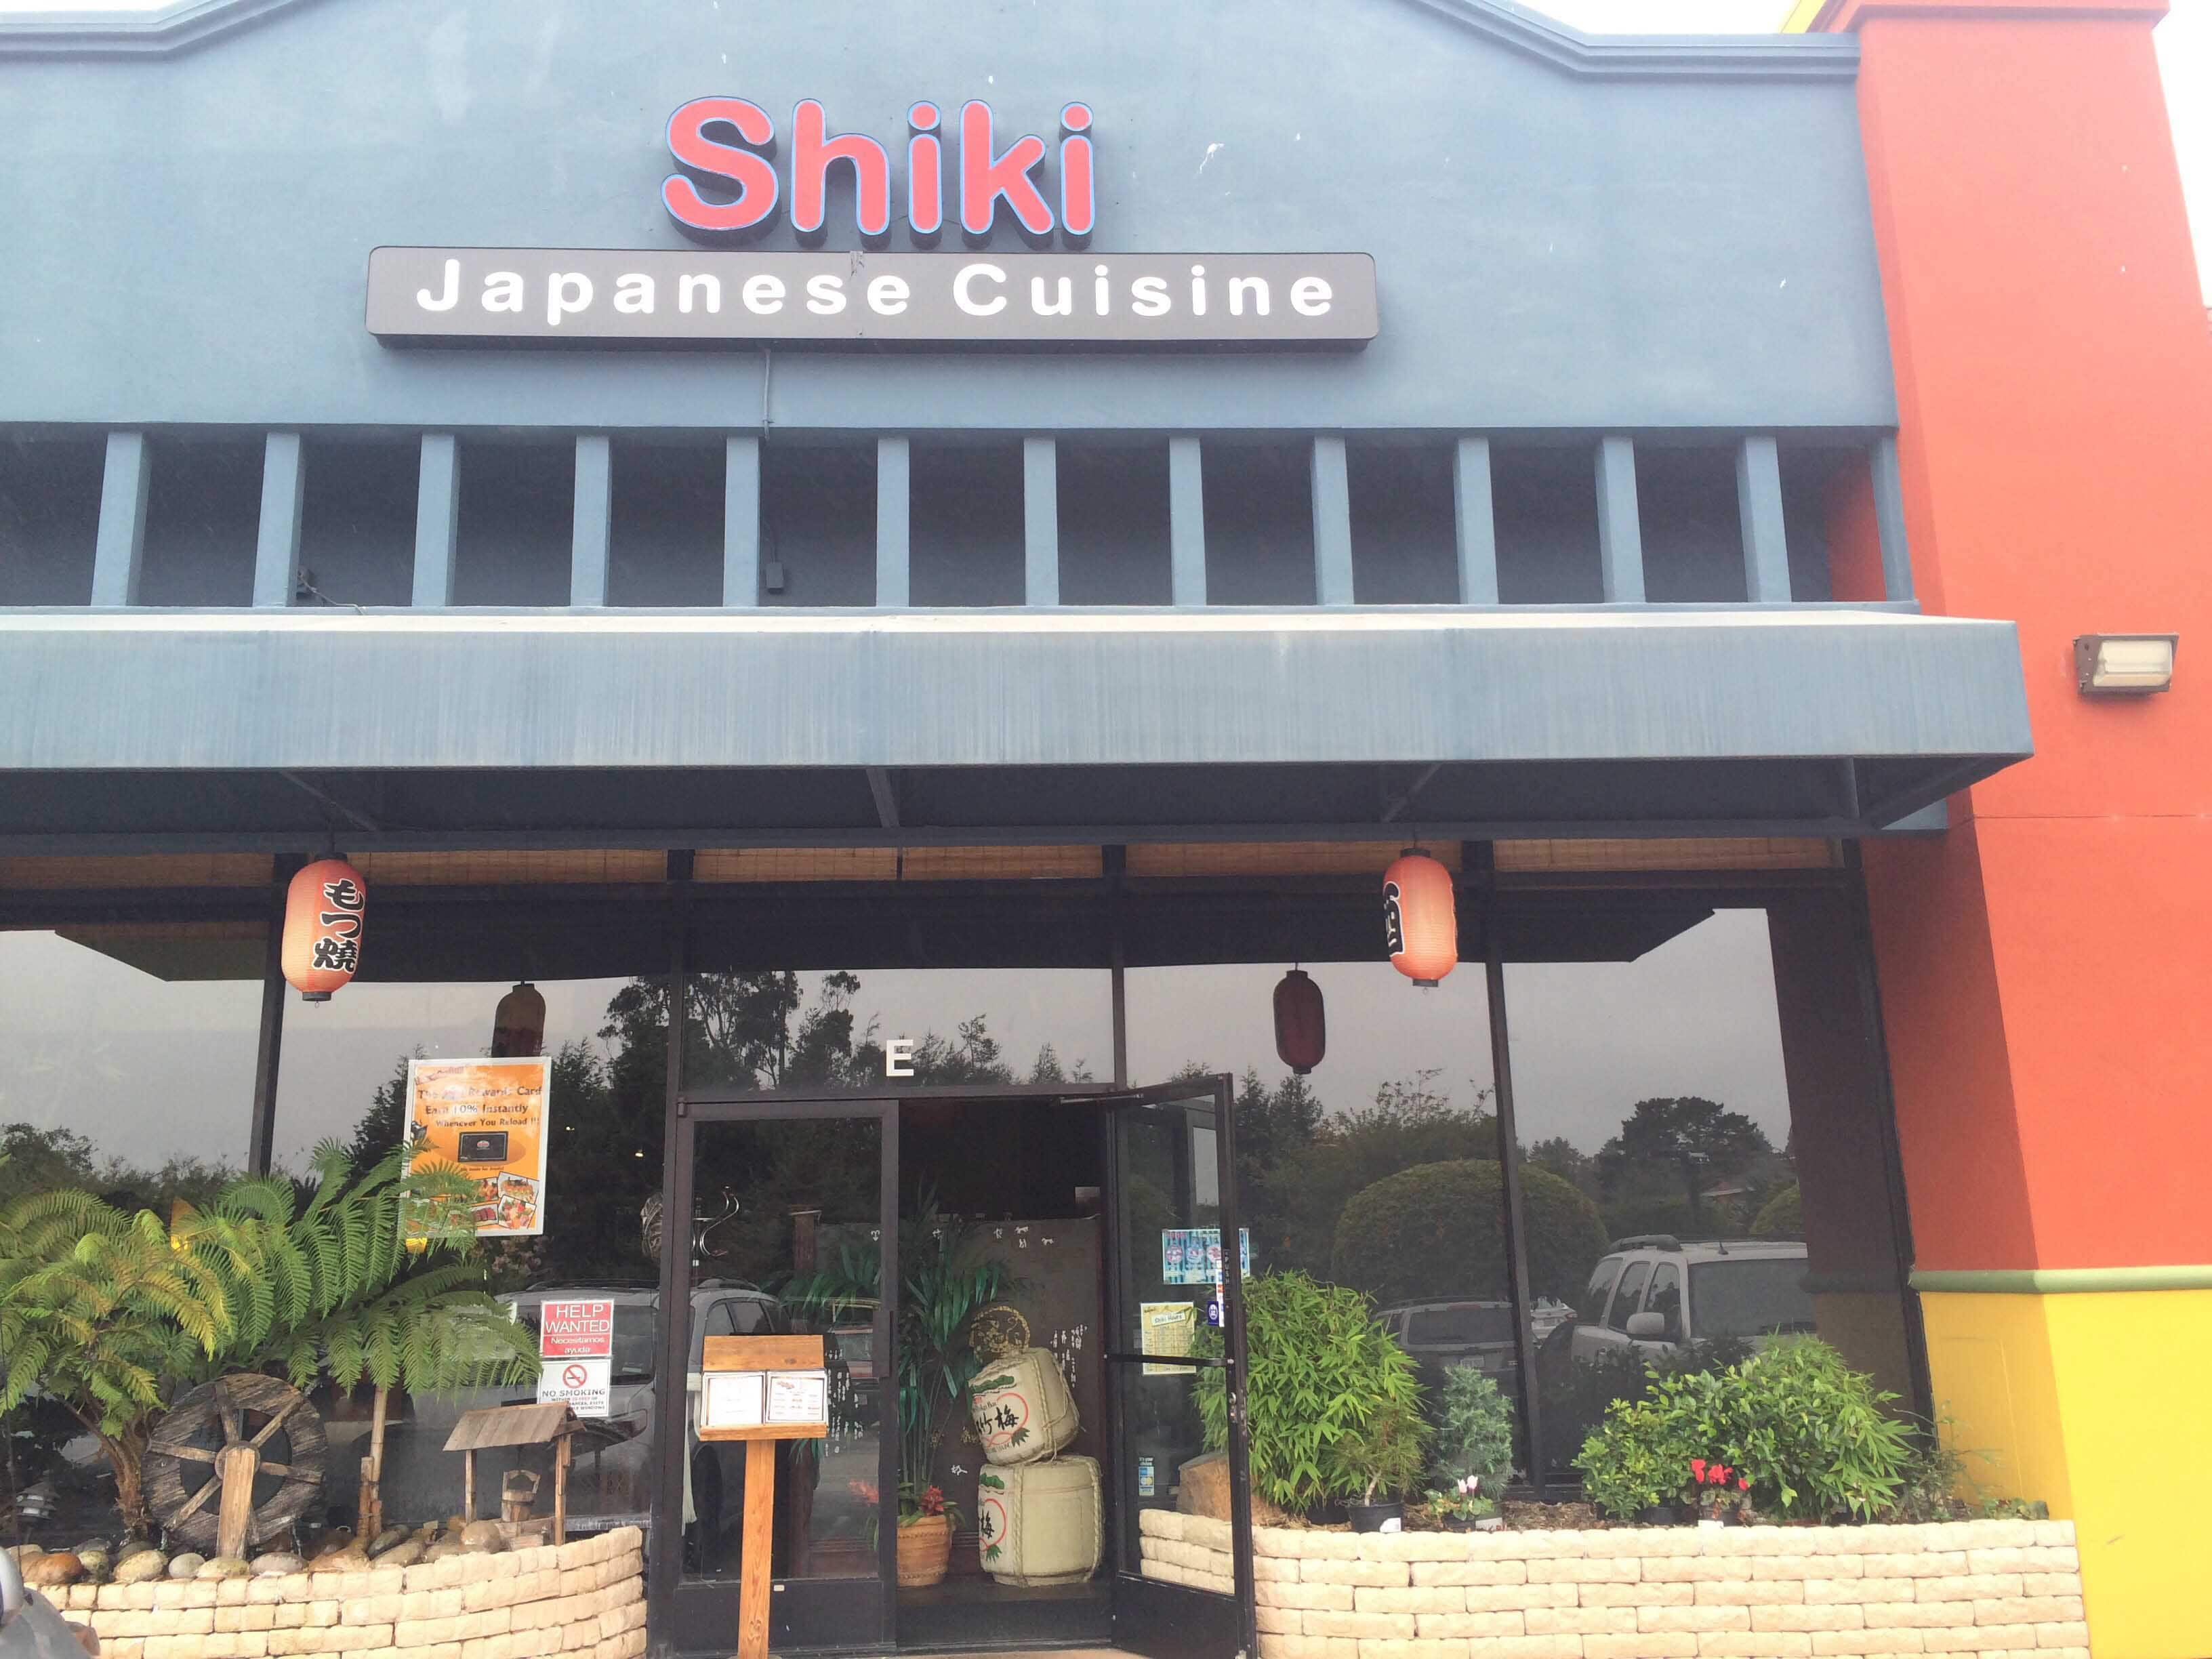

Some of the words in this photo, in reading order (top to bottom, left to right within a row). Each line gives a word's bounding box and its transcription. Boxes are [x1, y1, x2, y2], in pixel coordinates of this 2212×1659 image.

[660, 95, 1096, 239] Shiki
[415, 258, 912, 325] Japanese
[951, 261, 1333, 317] Cuisine
[886, 1039, 914, 1076] E
[517, 1086, 542, 1095] Card
[453, 1105, 478, 1113] 10%
[483, 1104, 529, 1114] Instantly
[556, 1304, 603, 1319] HELP
[546, 1319, 610, 1334] WANTED
[551, 1335, 605, 1345] Necesitamos
[564, 1346, 590, 1355] ayuda
[559, 1388, 605, 1397] SMOKING
